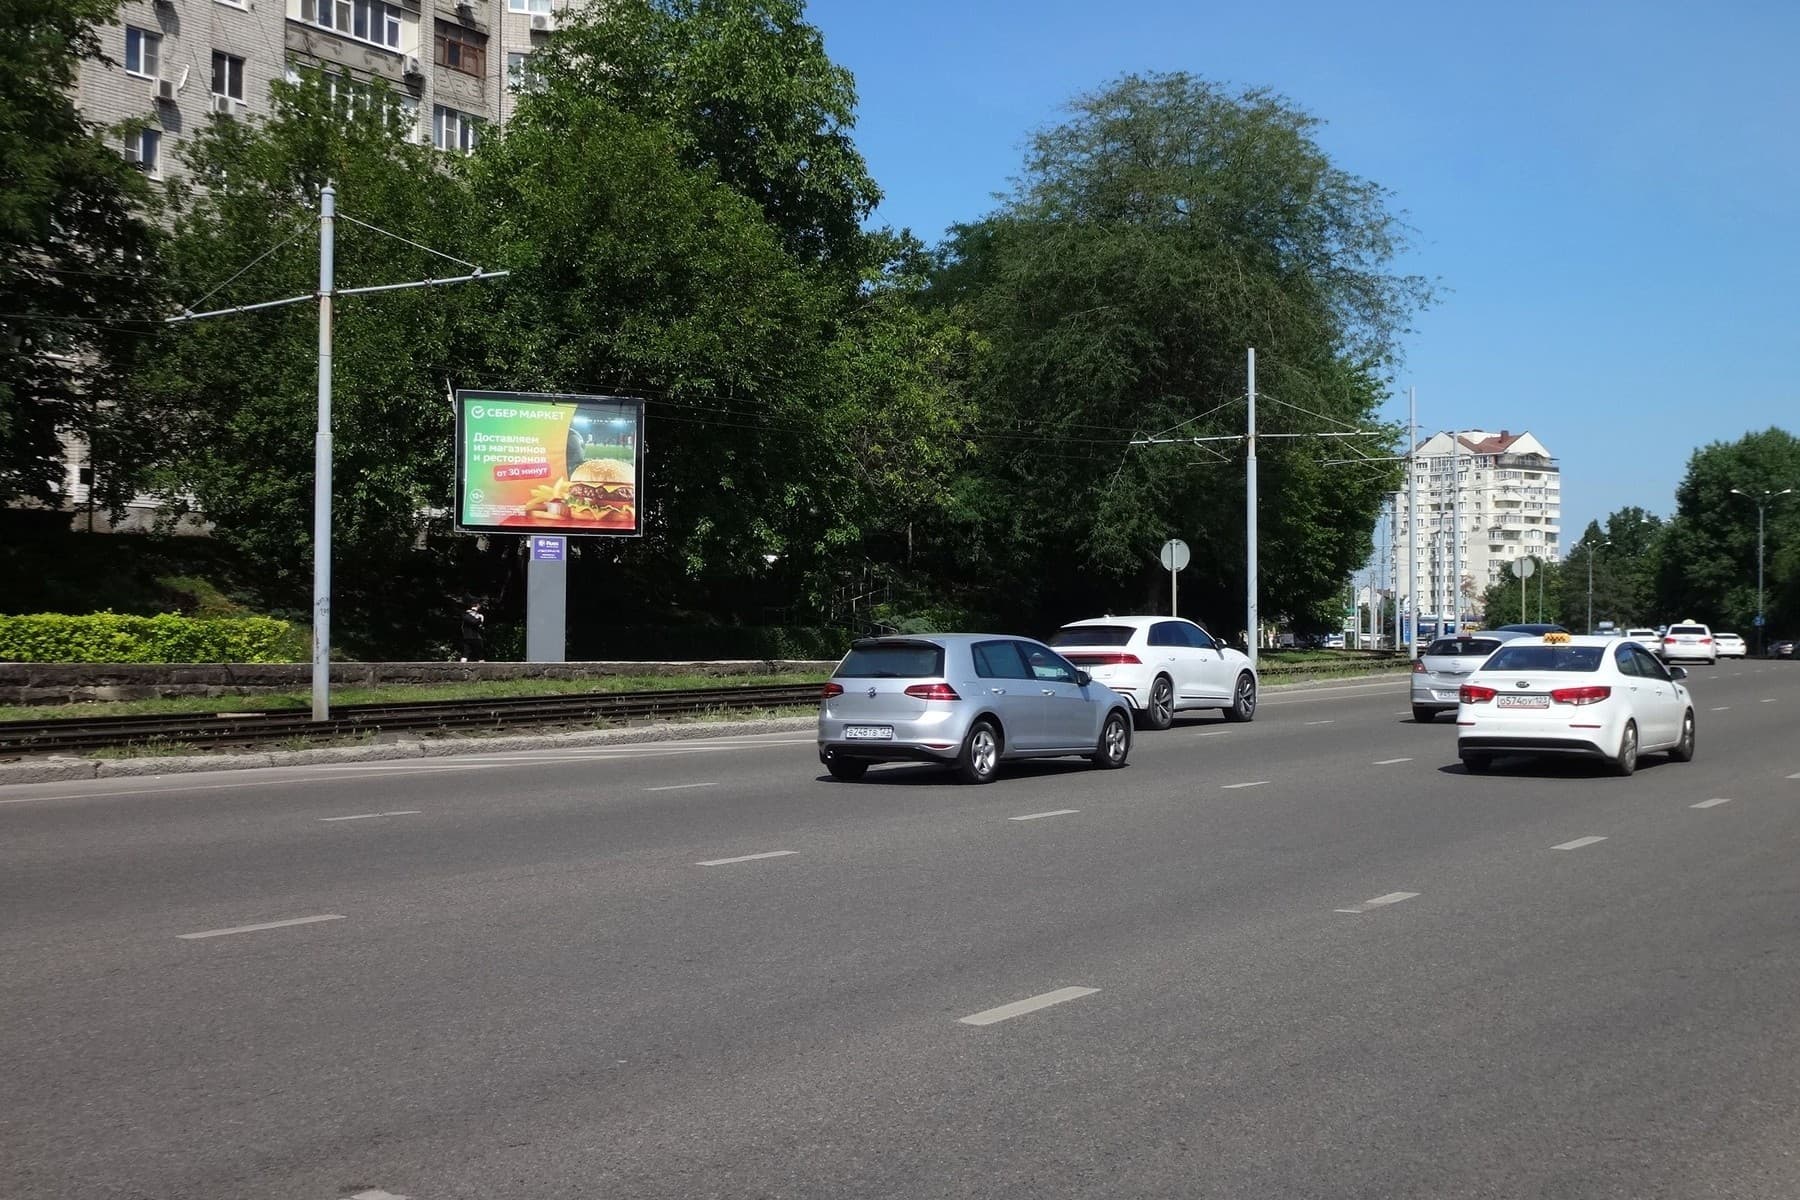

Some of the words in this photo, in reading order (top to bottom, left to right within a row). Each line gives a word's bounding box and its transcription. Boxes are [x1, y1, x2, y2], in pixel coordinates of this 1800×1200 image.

[487, 408, 517, 418] СБЕР
[520, 409, 565, 420] МАРКЕТ
[474, 432, 539, 443] Доставляем
[473, 444, 487, 452] из
[489, 446, 546, 454] магазинов
[483, 454, 547, 465] ресторанов
[509, 468, 520, 476] 30
[521, 467, 548, 476] минут
